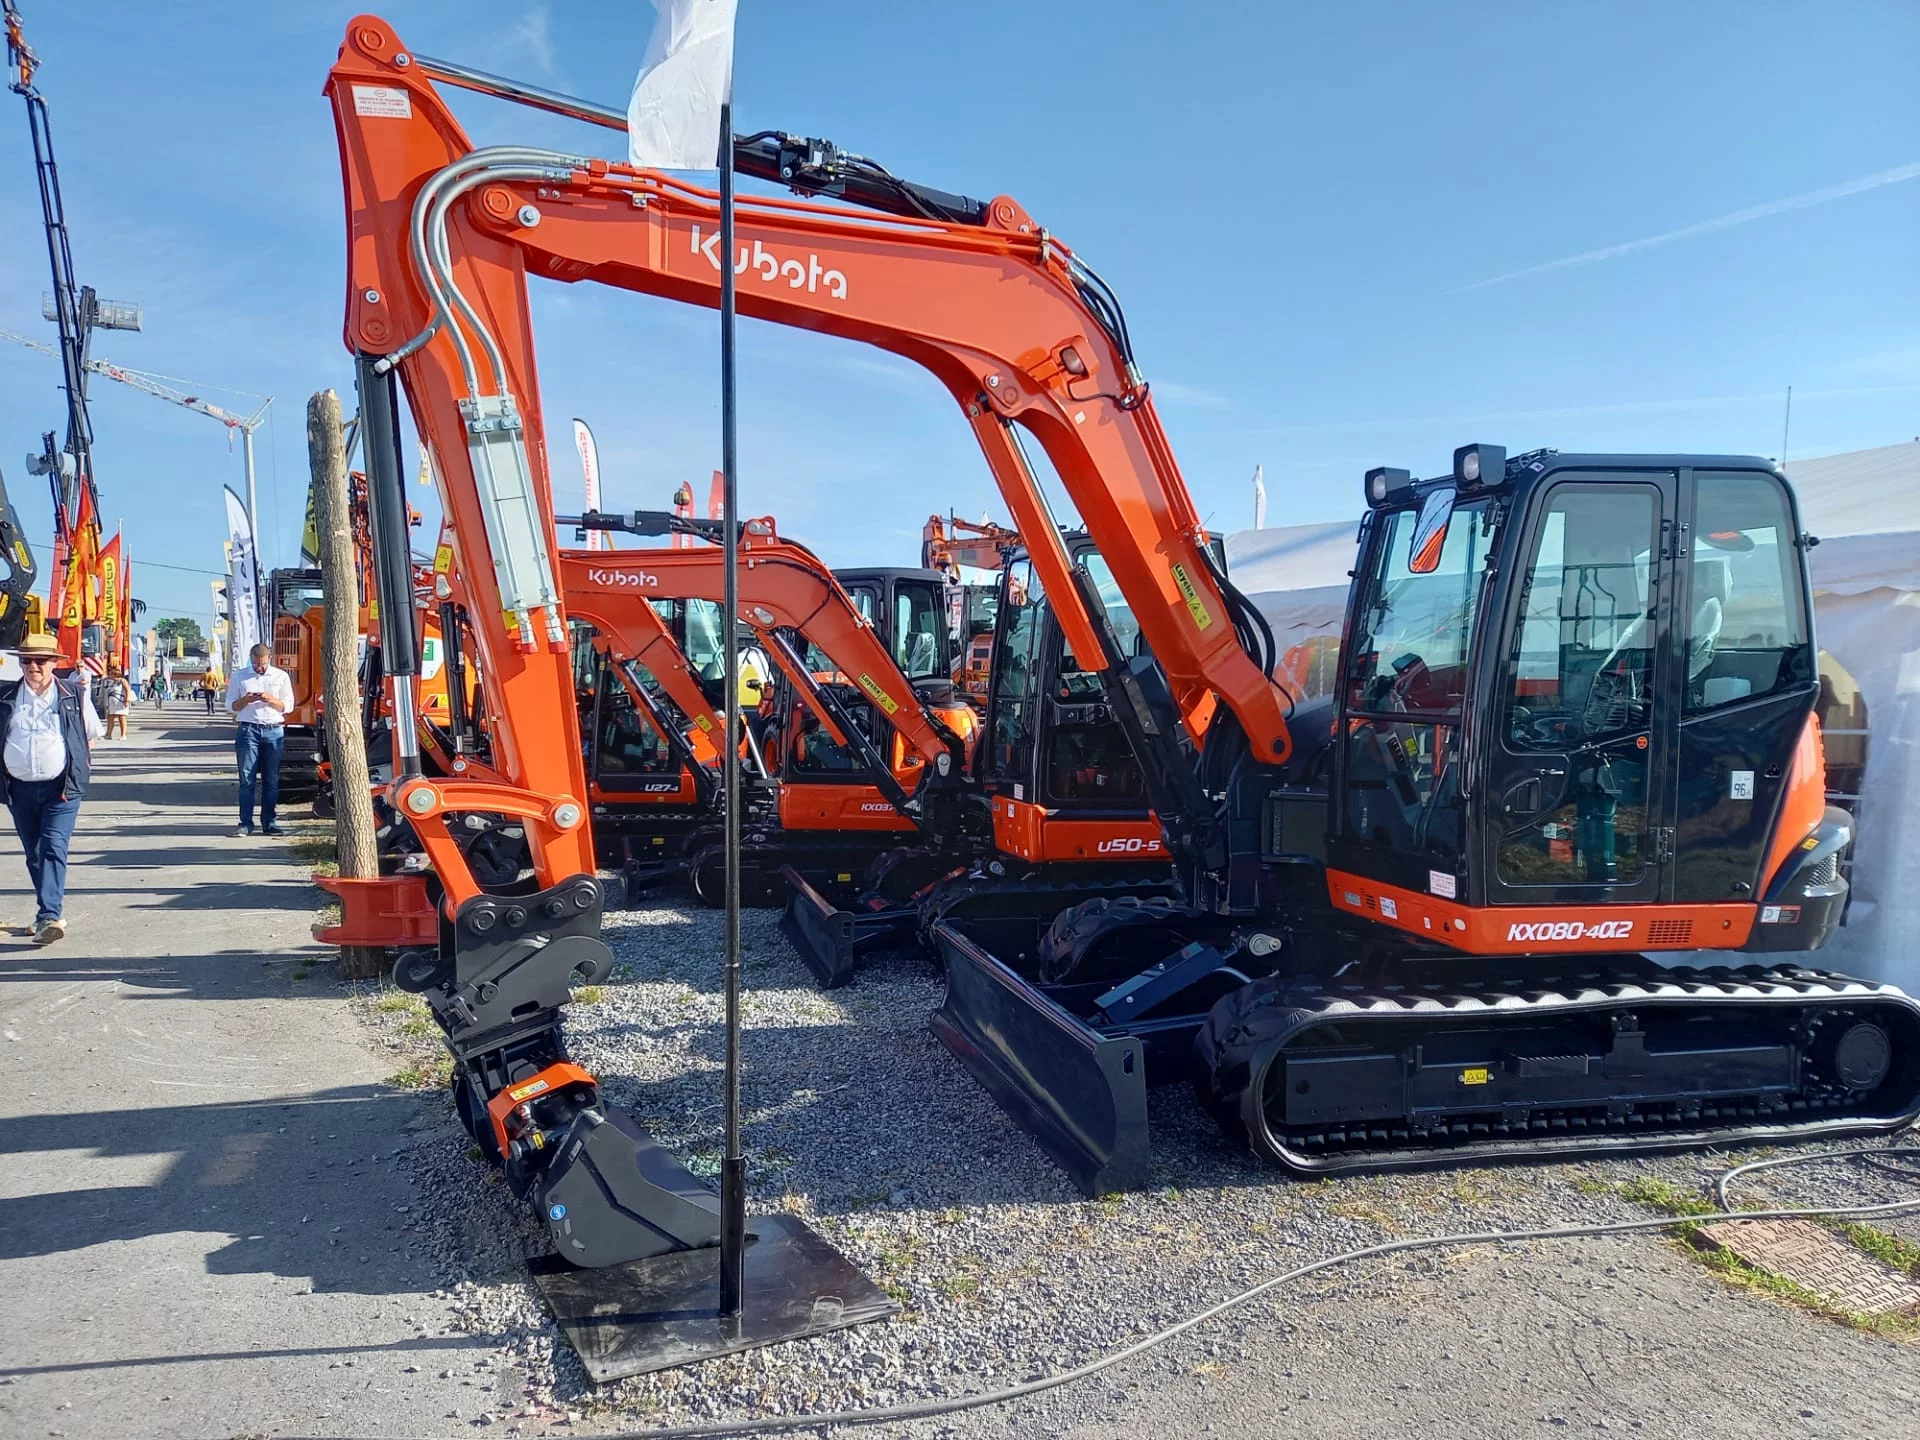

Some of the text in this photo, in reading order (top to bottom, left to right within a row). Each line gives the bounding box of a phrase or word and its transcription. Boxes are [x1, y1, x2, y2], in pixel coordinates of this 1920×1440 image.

[691, 224, 848, 300] Kubota
[588, 569, 658, 587] Kubota
[644, 784, 679, 792] U27-4
